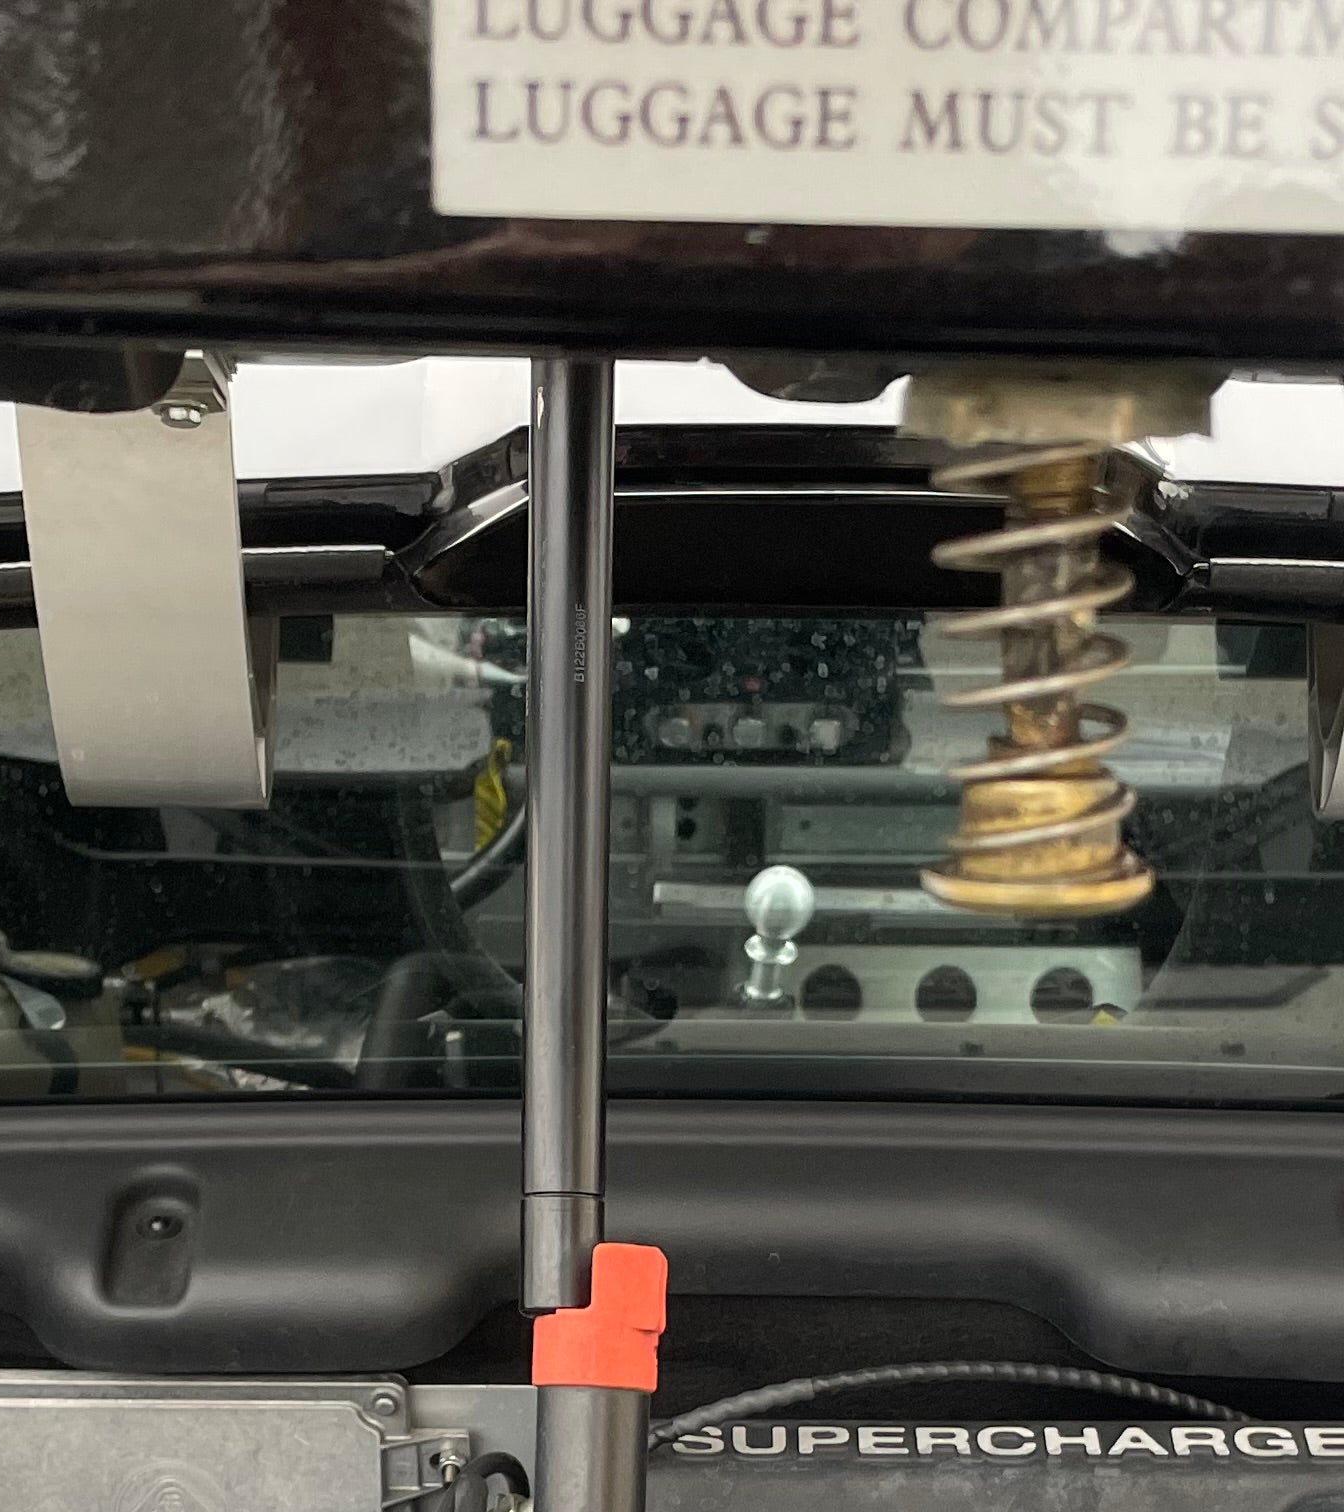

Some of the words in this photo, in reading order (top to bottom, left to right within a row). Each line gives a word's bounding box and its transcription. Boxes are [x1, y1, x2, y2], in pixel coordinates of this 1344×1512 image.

[471, 0, 862, 50] LUGGAGE
[471, 79, 860, 152] LUGGAGE
[899, 89, 1133, 157] MUST
[1168, 90, 1274, 159] BE
